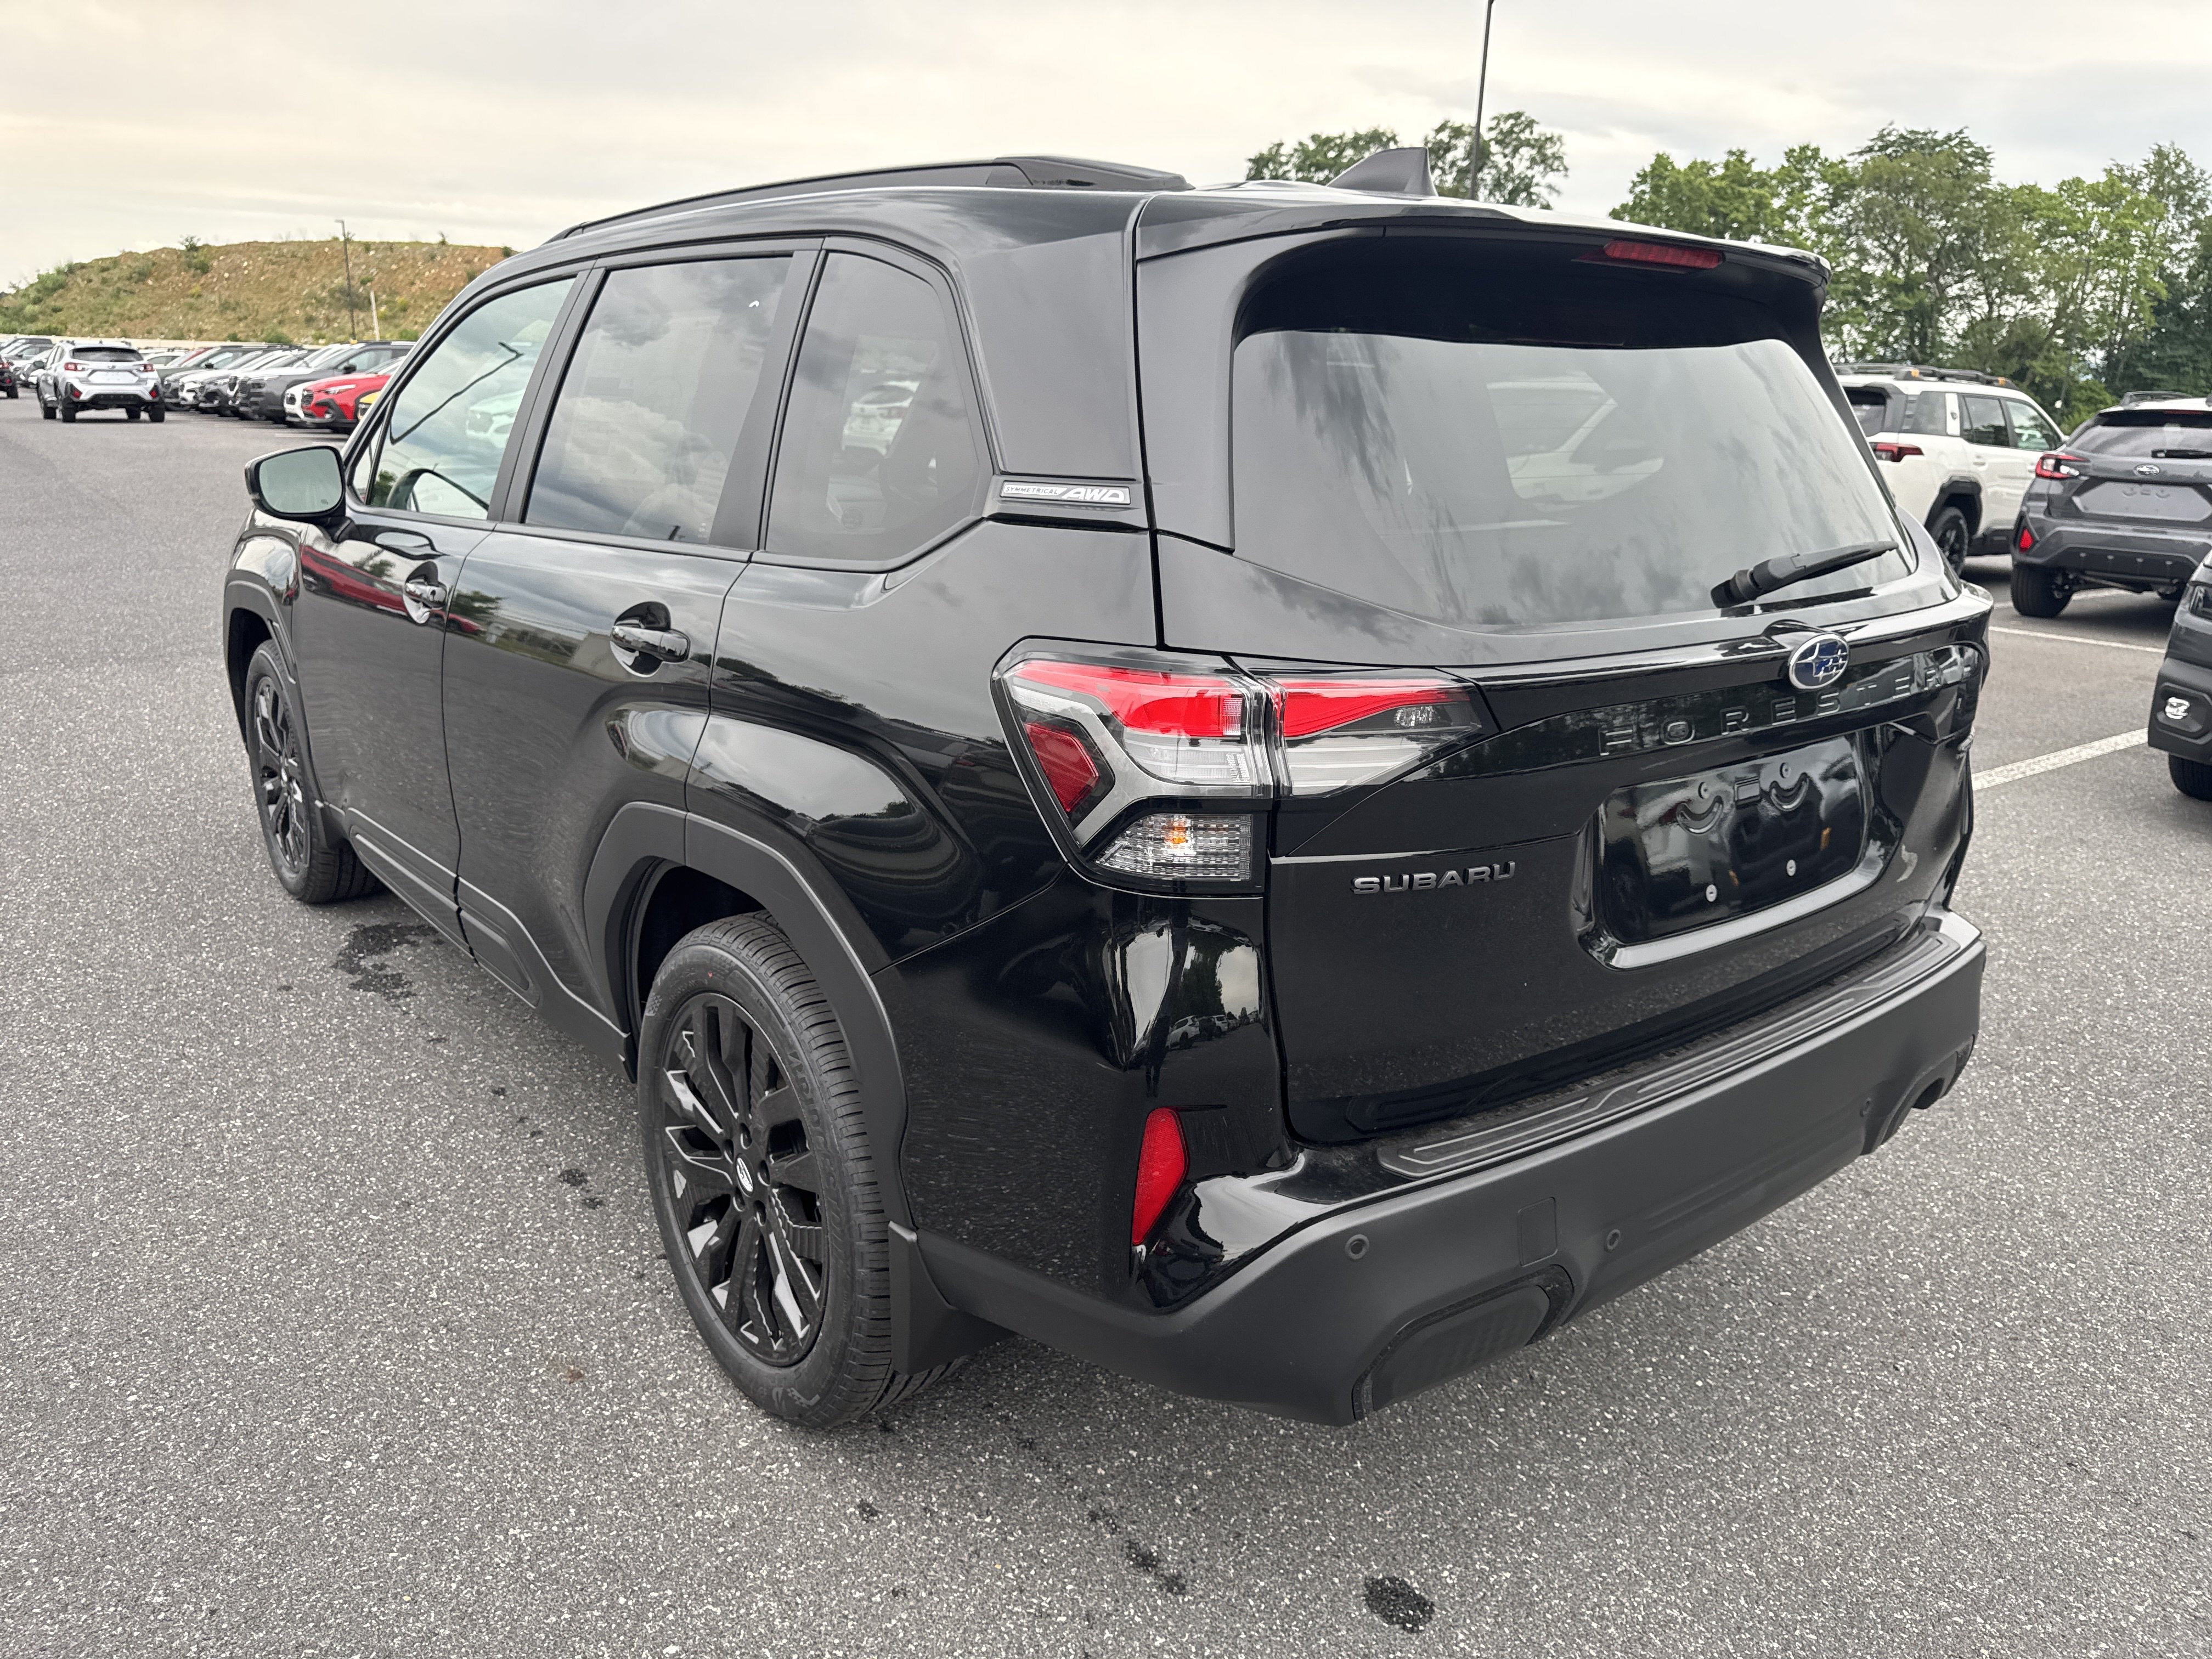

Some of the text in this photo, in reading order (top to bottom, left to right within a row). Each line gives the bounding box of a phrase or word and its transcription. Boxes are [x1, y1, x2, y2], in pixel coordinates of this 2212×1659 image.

[1006, 487, 1125, 501] SYMMETRICAL AWD
[1599, 668, 1943, 757] FORESTER
[1350, 861, 1516, 895] SUBARU
